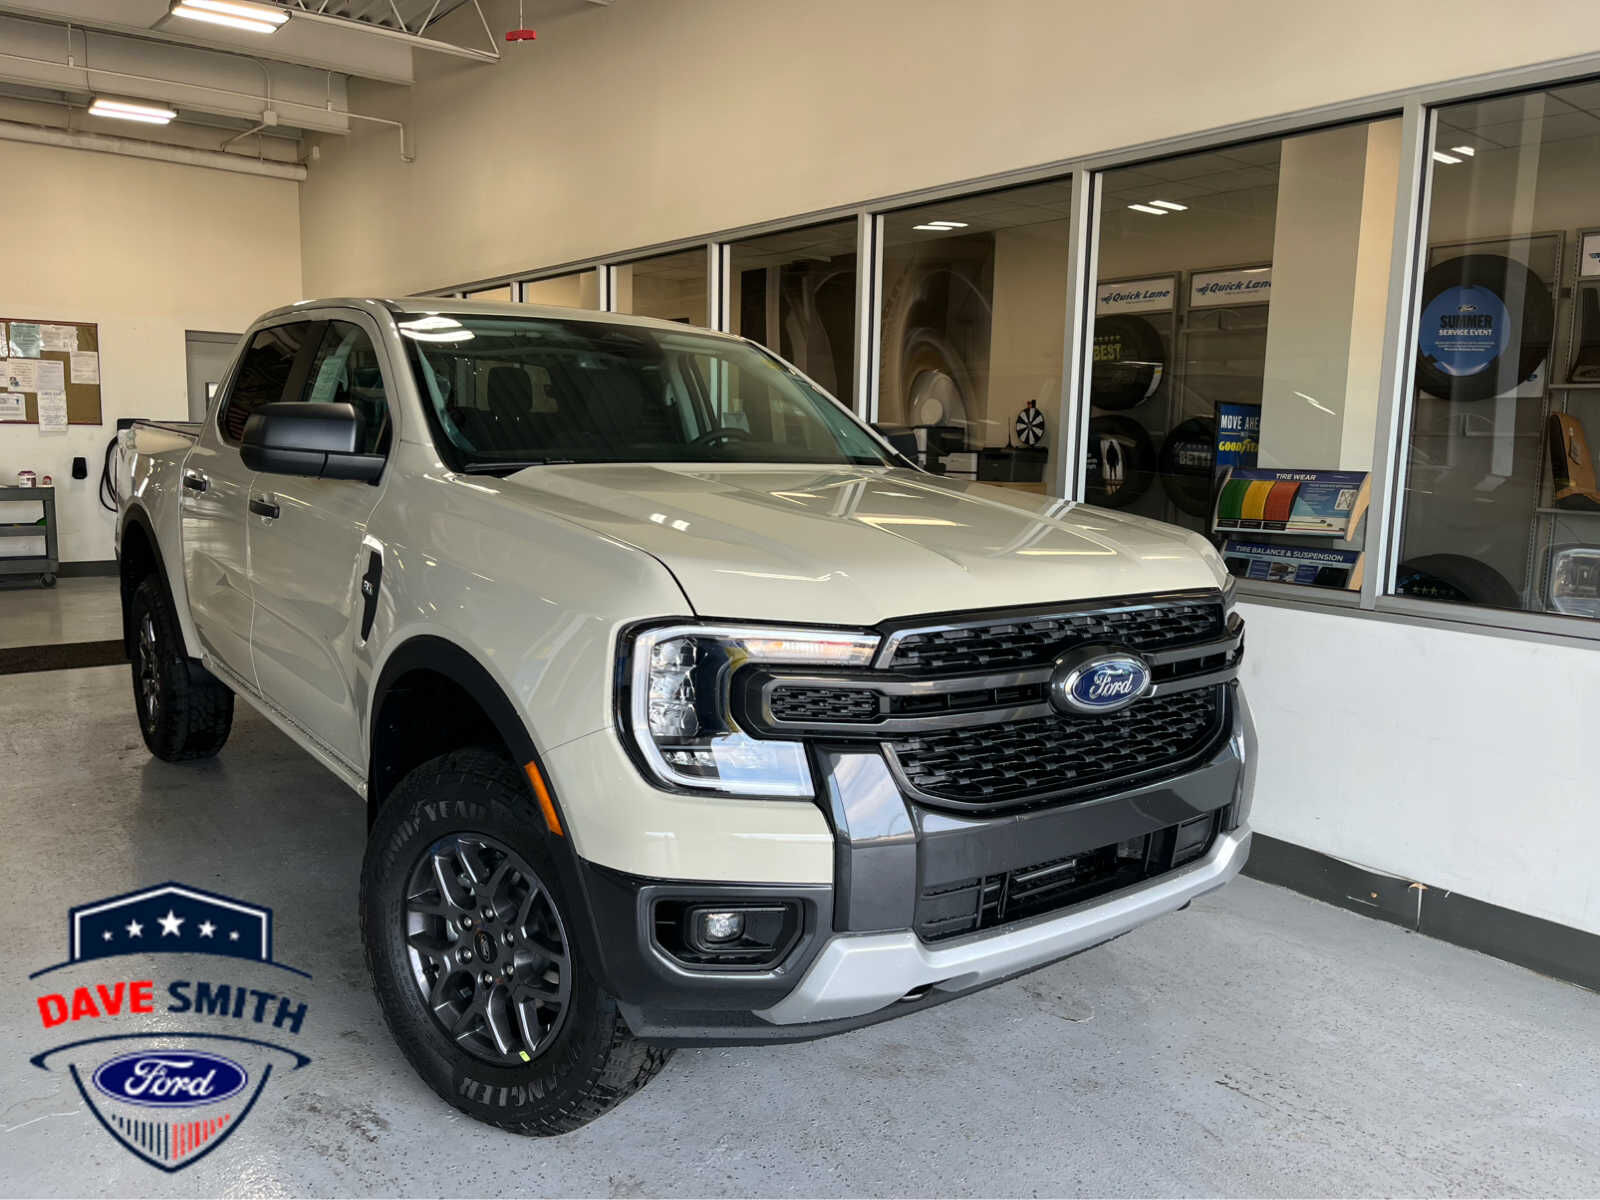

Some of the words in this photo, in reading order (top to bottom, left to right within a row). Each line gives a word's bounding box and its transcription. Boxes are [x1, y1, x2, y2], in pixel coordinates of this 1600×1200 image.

[1210, 280, 1242, 293] Quick
[1112, 291, 1140, 302] Quick
[1142, 289, 1170, 299] Lane
[1440, 314, 1493, 329] SUMMER
[1220, 415, 1242, 430] MOVE
[1293, 473, 1317, 481] WEAR
[1235, 545, 1251, 553] TIRE
[1251, 547, 1285, 557] BALANCE
[1293, 551, 1344, 561] SUSPENSION
[1089, 669, 1134, 699] Ford
